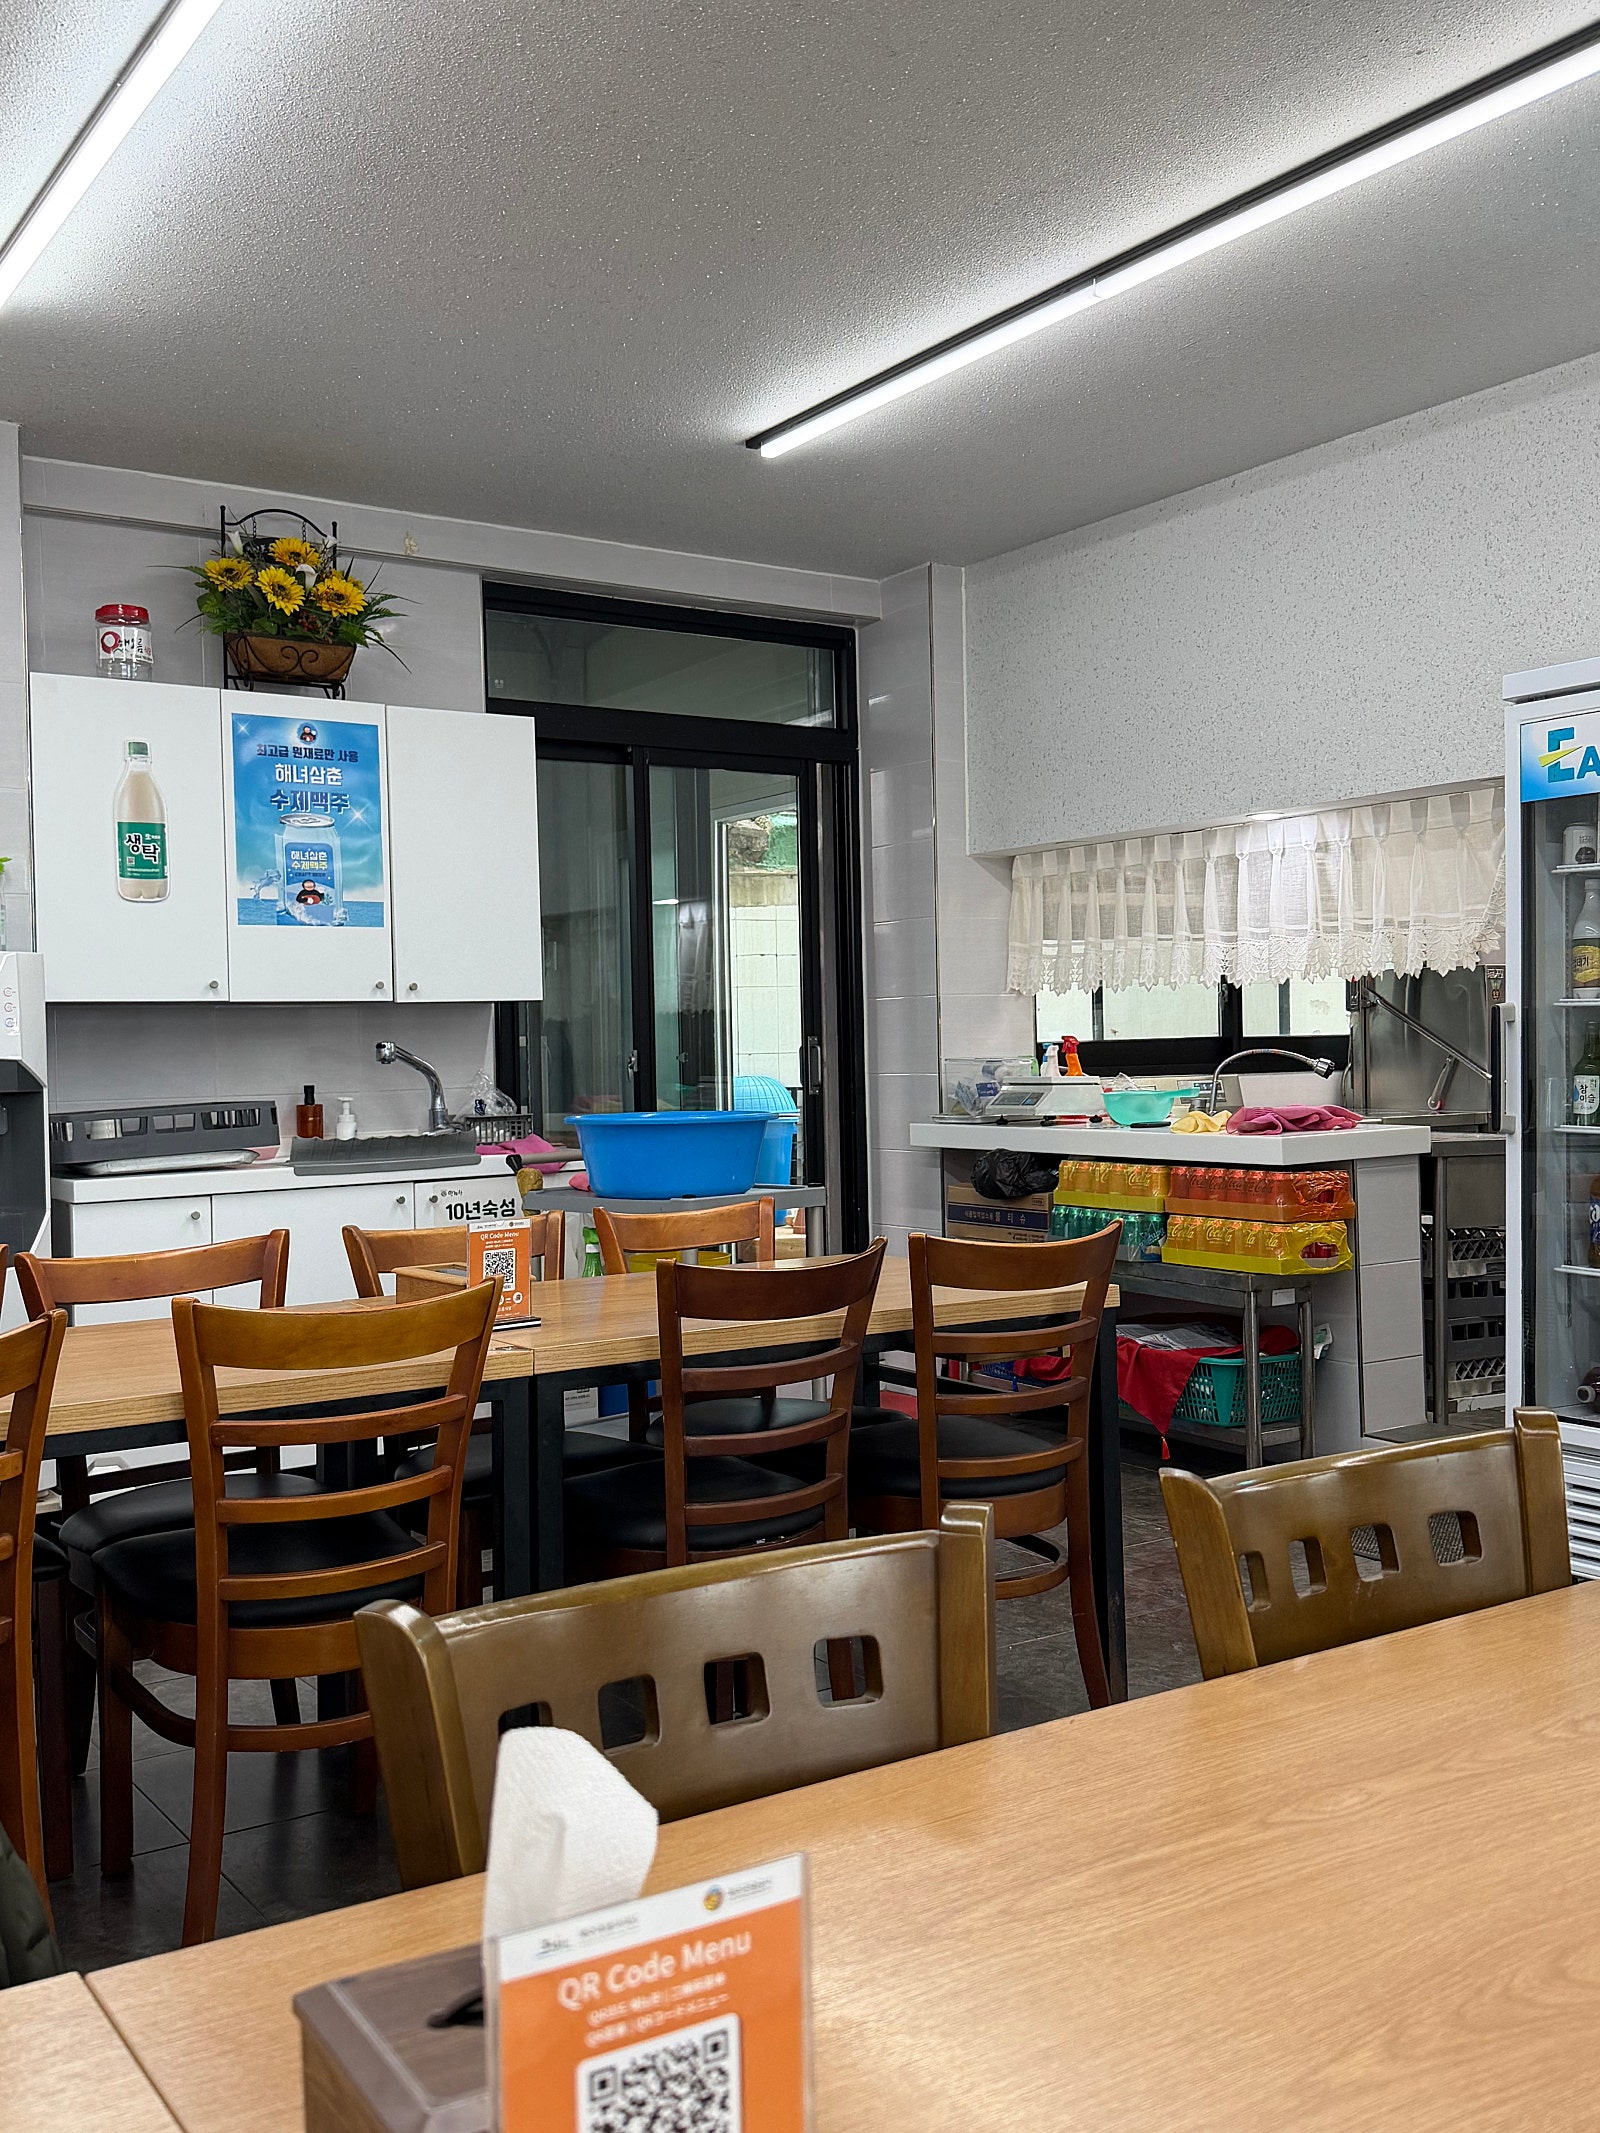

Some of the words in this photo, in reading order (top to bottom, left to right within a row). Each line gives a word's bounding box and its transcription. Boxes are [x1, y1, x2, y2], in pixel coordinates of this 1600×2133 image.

[257, 744, 289, 758] 최고급
[293, 746, 335, 761] 원재료만
[338, 750, 359, 762] 사용
[275, 763, 343, 786] 해녀삼춘
[270, 789, 350, 815] 수제맥주
[124, 833, 160, 865] 생탁
[291, 850, 327, 861] 해녀삼춘
[291, 861, 328, 870] 수제맥주
[446, 1198, 516, 1221] 10년숙성
[557, 1971, 601, 2012] QR
[605, 1951, 675, 1994] Code
[681, 1930, 753, 1972] Menu
